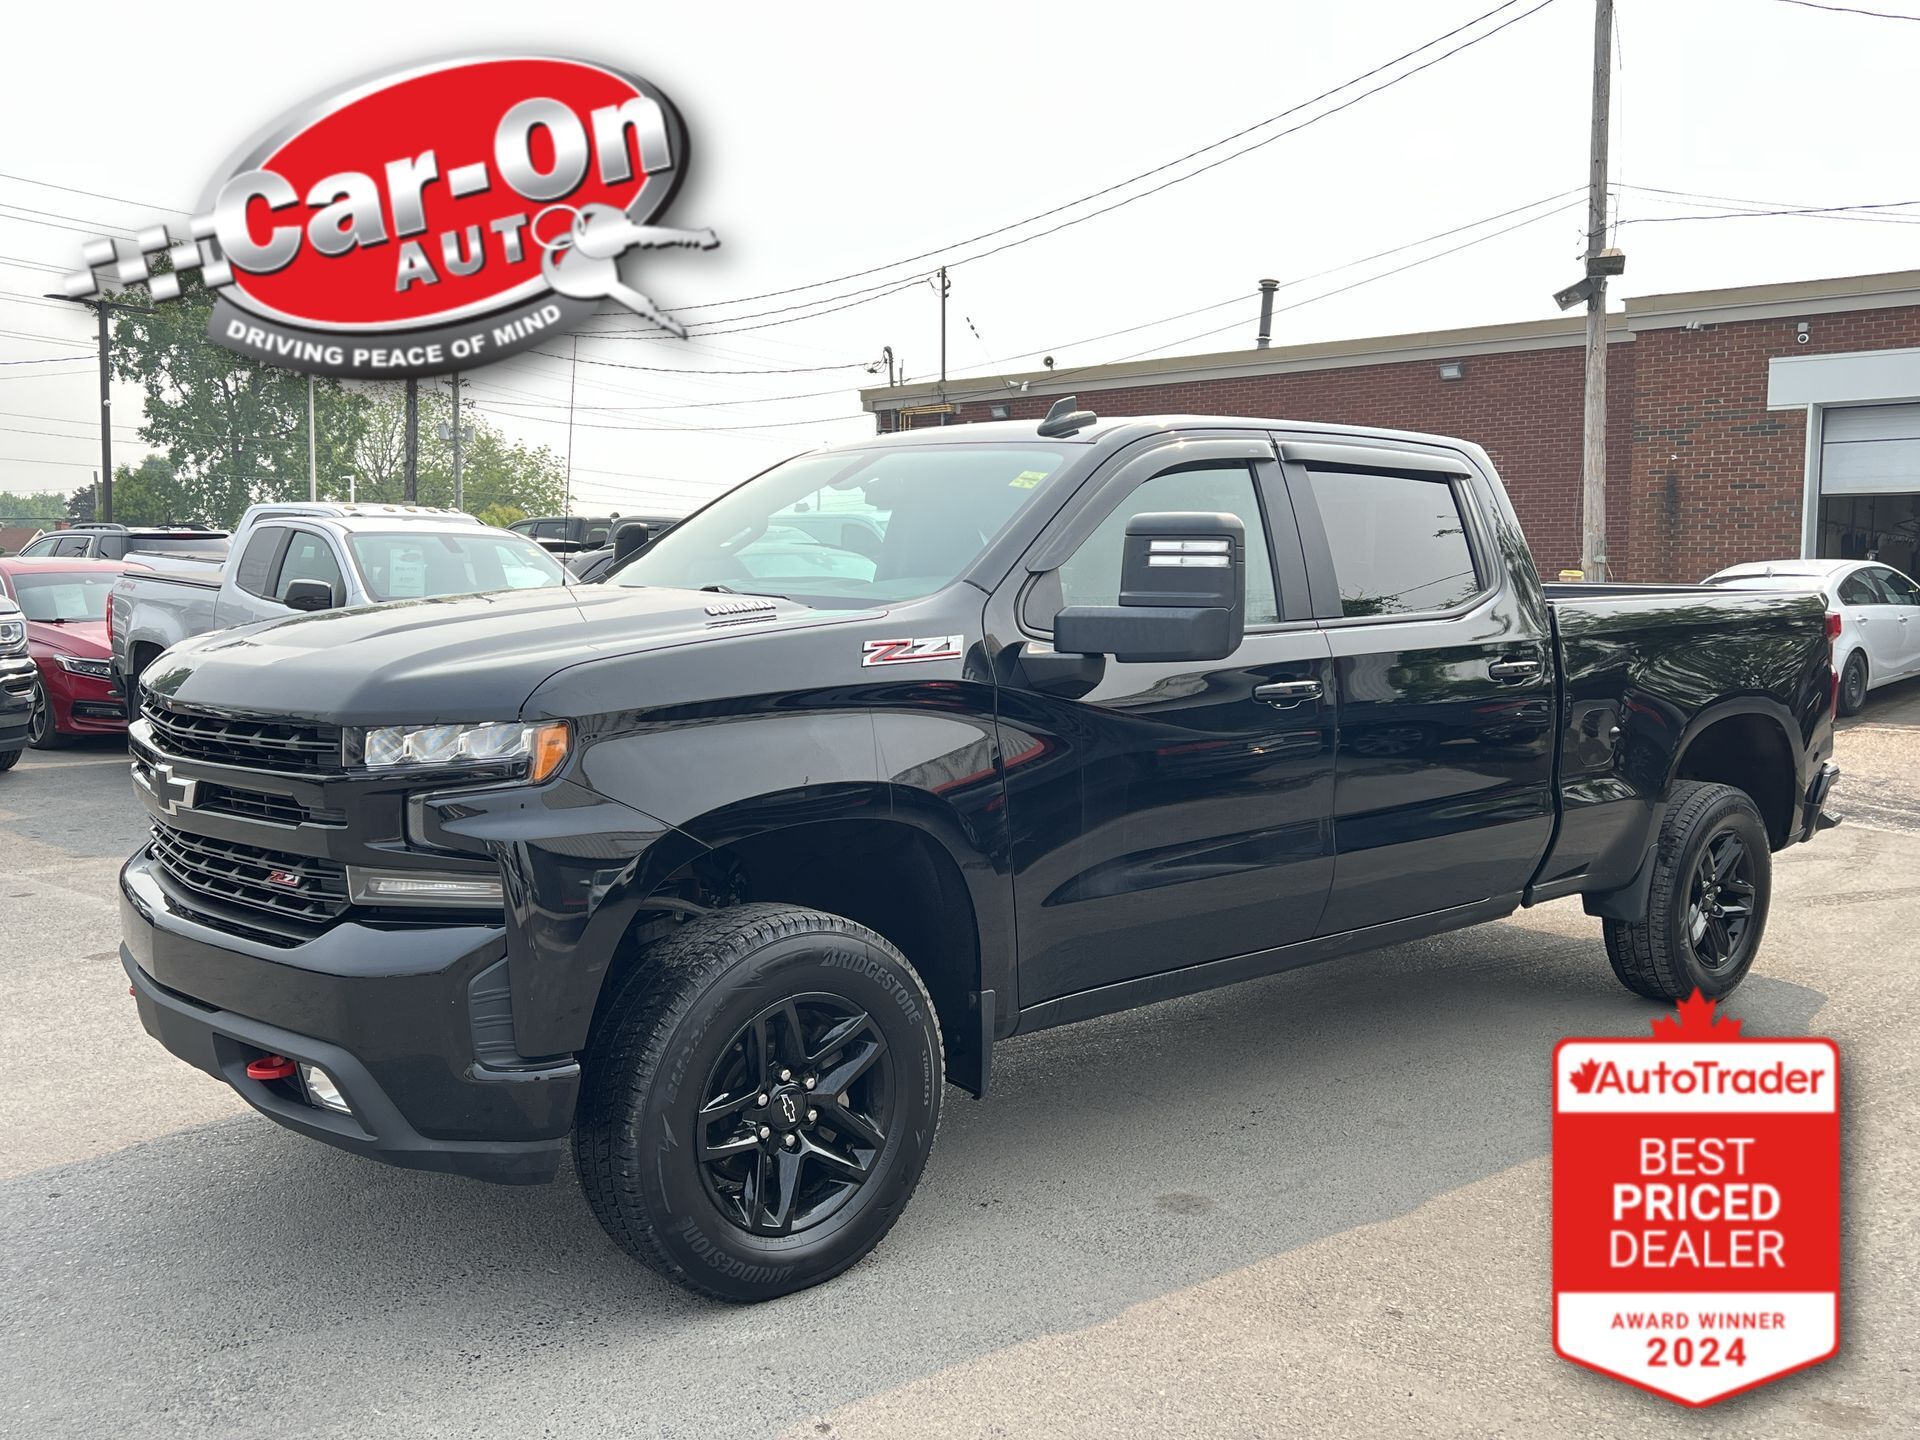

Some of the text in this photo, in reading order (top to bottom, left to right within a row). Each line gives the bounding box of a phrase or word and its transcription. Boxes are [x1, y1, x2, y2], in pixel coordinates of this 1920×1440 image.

[861, 635, 964, 667] Z71
[269, 871, 301, 887] Z71
[819, 946, 923, 1025] BRIDGESTONE
[676, 1216, 794, 1285] BRIDGESTONE
